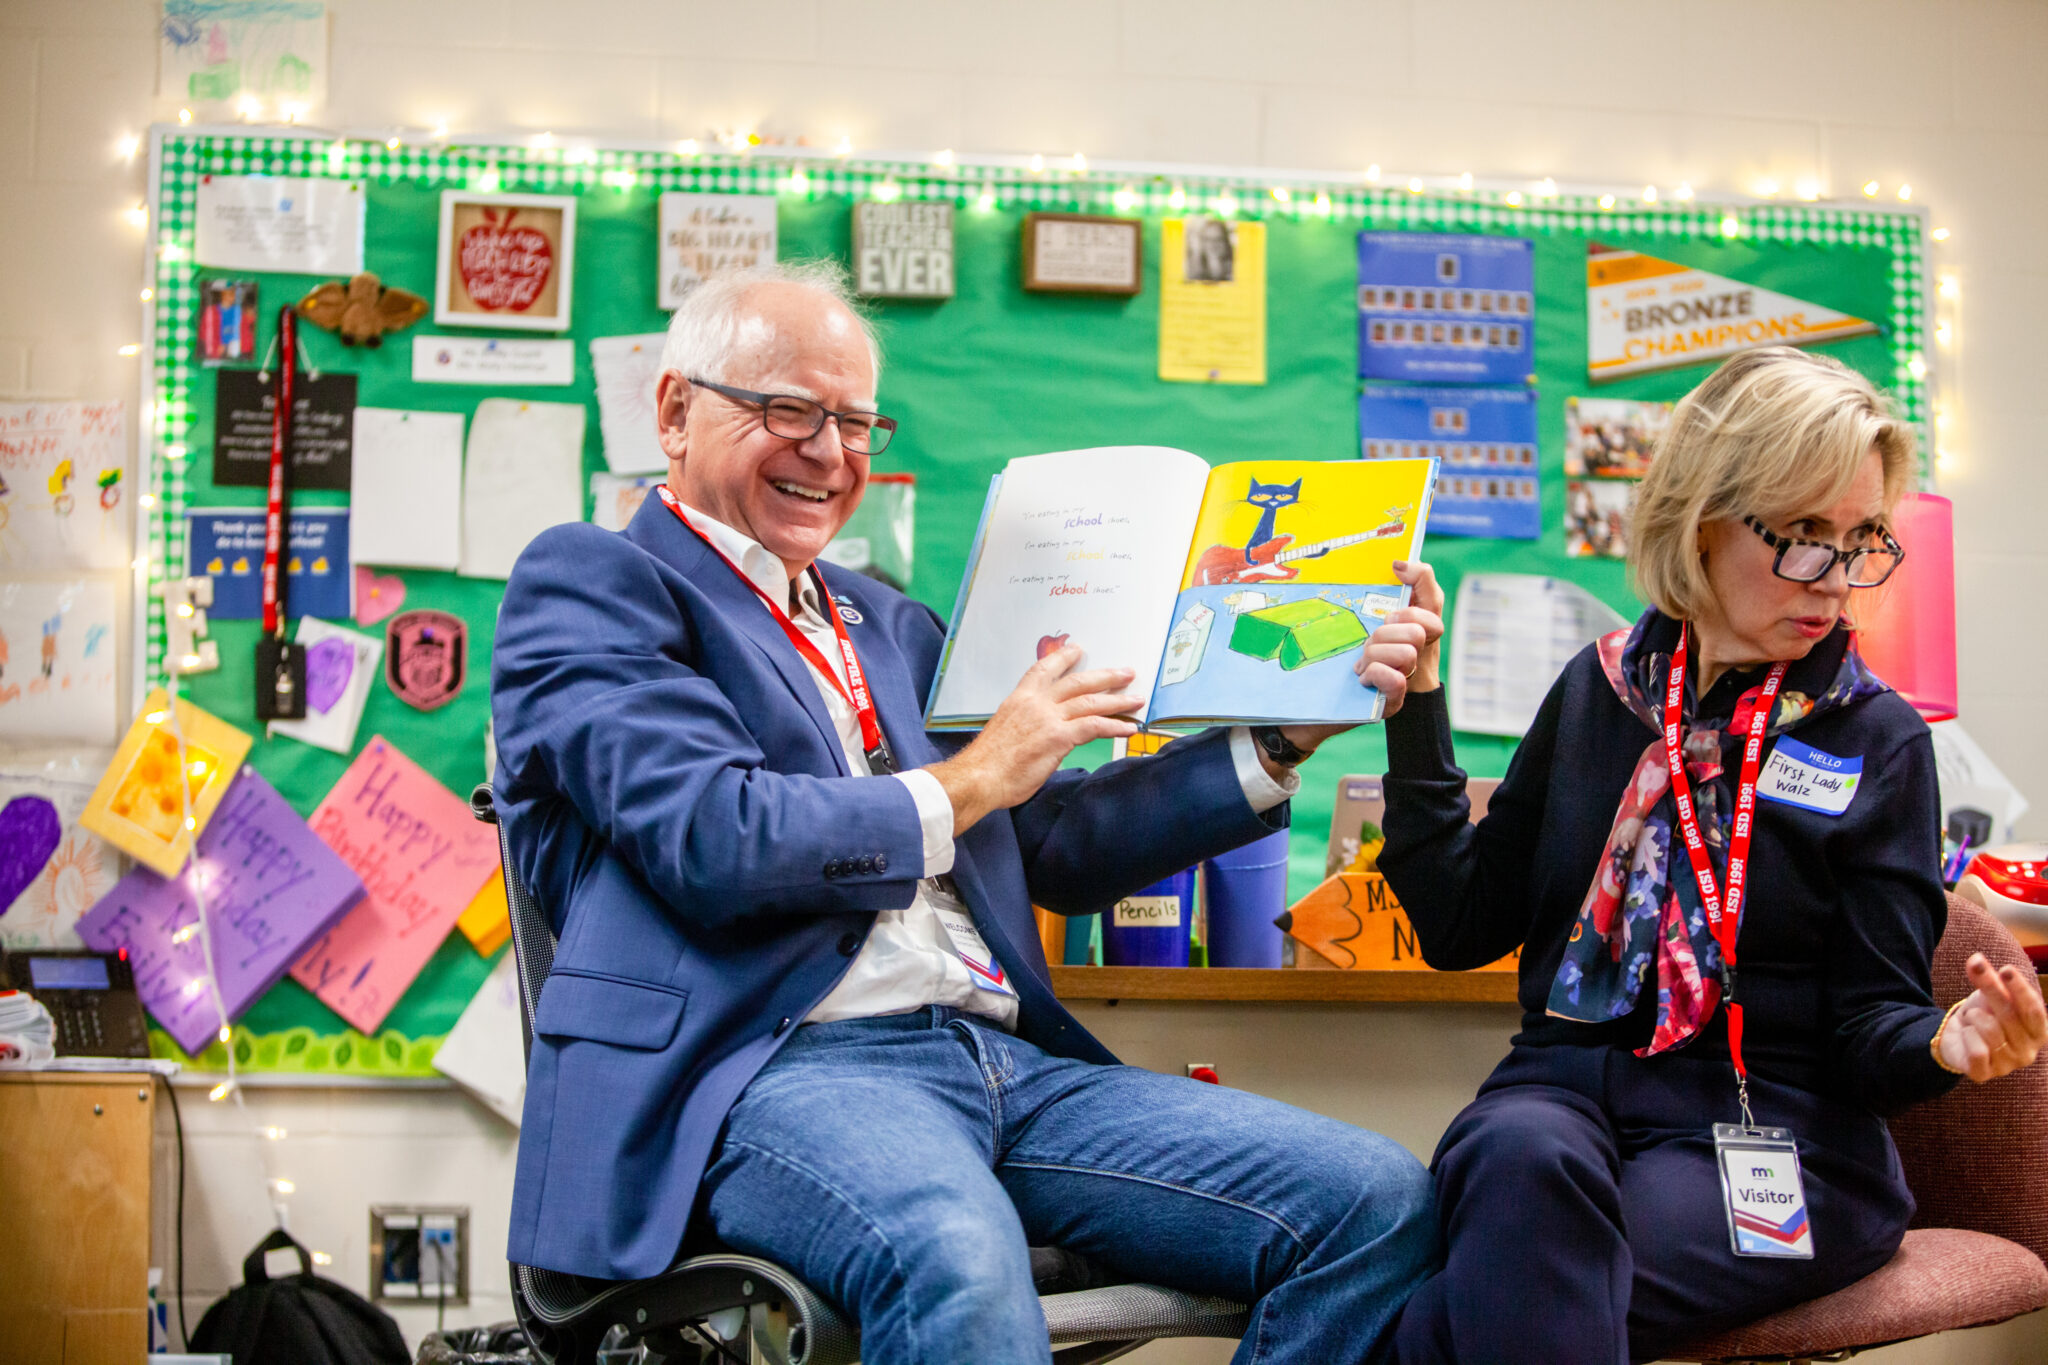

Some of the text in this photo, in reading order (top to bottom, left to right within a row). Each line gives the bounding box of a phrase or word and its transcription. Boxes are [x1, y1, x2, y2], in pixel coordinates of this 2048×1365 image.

[862, 249, 950, 292] EVER
[1625, 290, 1753, 332] BRONZE
[1623, 312, 1807, 361] CHAMPIONS
[1064, 512, 1103, 529] school
[1037, 540, 1060, 550] eating
[1066, 546, 1105, 561] school
[1022, 575, 1045, 585] eating
[1048, 581, 1089, 597] school
[839, 638, 864, 687] INSPIRE
[1670, 665, 1683, 686] ISD
[1668, 686, 1681, 708] 199!
[1762, 675, 1780, 696] ISD
[1666, 723, 1682, 775] ISD 199!
[1746, 711, 1767, 762] ISD 199!
[1768, 753, 1806, 782] First
[1812, 773, 1843, 793] Lady
[1808, 751, 1843, 768] HELLO
[1776, 779, 1811, 796] Walz
[354, 762, 453, 872] Happy
[1677, 793, 1702, 850] ISD 199!
[1735, 782, 1754, 838] ISD 199!
[220, 788, 315, 901] Happy
[1697, 868, 1723, 924] ISD 199!
[1726, 857, 1745, 914] ISD 199!
[1119, 899, 1178, 920] Pencils
[1739, 1187, 1795, 1204] Visitor
